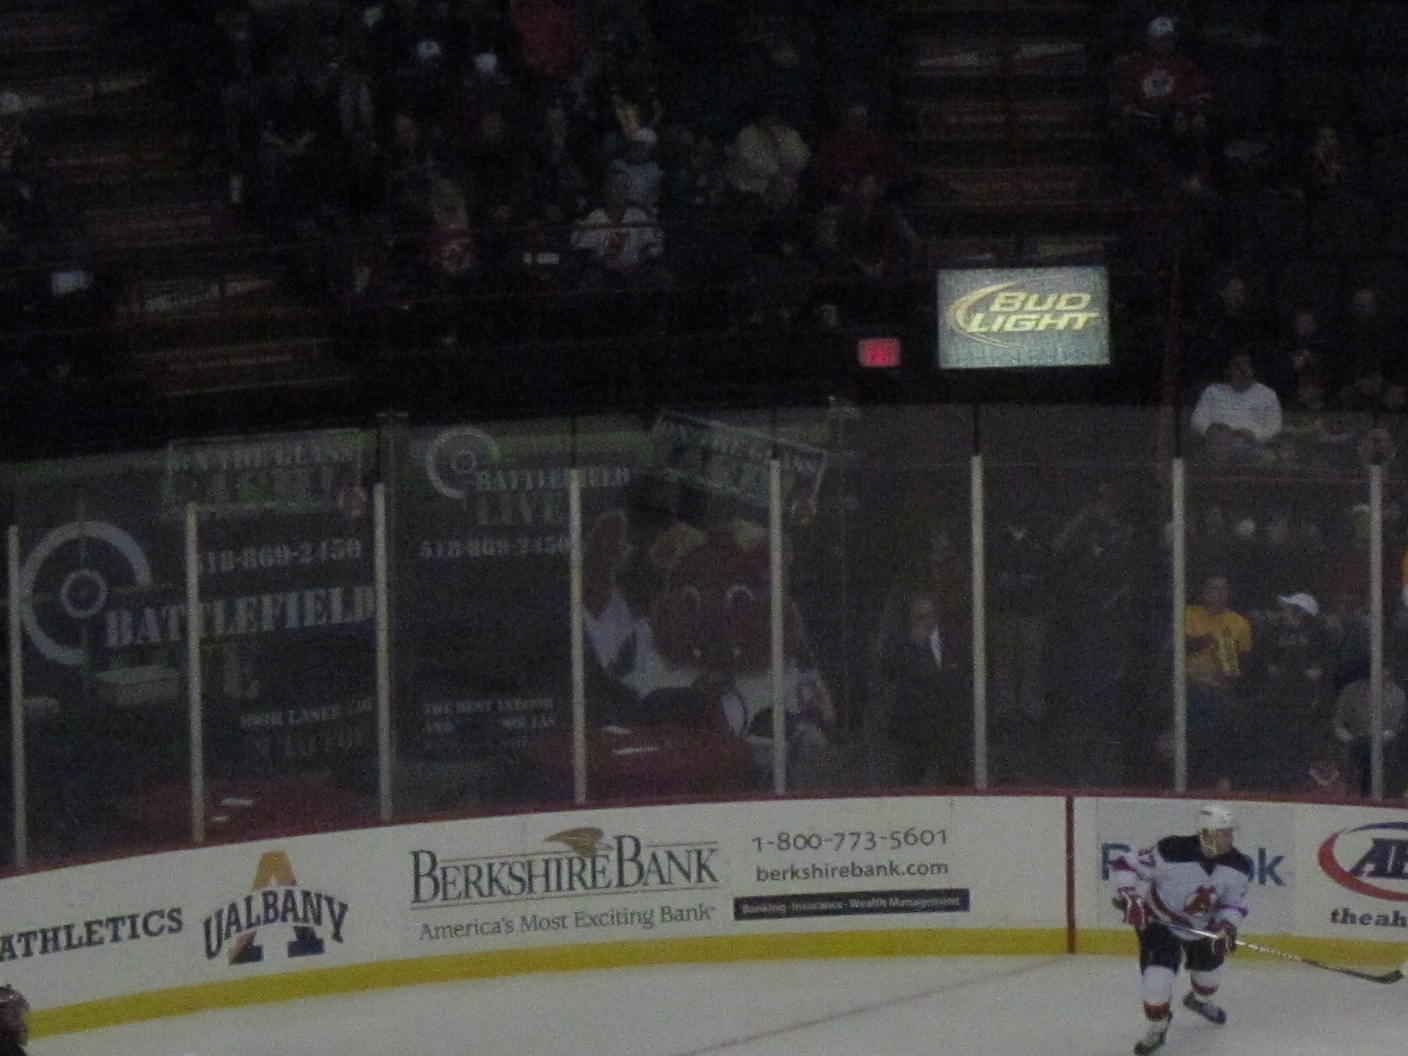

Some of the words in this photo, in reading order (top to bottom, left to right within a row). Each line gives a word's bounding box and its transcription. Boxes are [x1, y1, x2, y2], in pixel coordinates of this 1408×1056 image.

[988, 292, 1092, 312] BUD
[966, 311, 1101, 333] LIGHT
[105, 586, 376, 648] BATTLEFIELD
[752, 827, 948, 851] 1-800-773-5601
[756, 861, 949, 882] berkshirebank.com
[0, 907, 184, 961] ATHLETICS
[203, 889, 349, 960] UALBANY
[419, 917, 514, 941] America's
[520, 913, 568, 933] Most
[574, 908, 655, 930] Exciting
